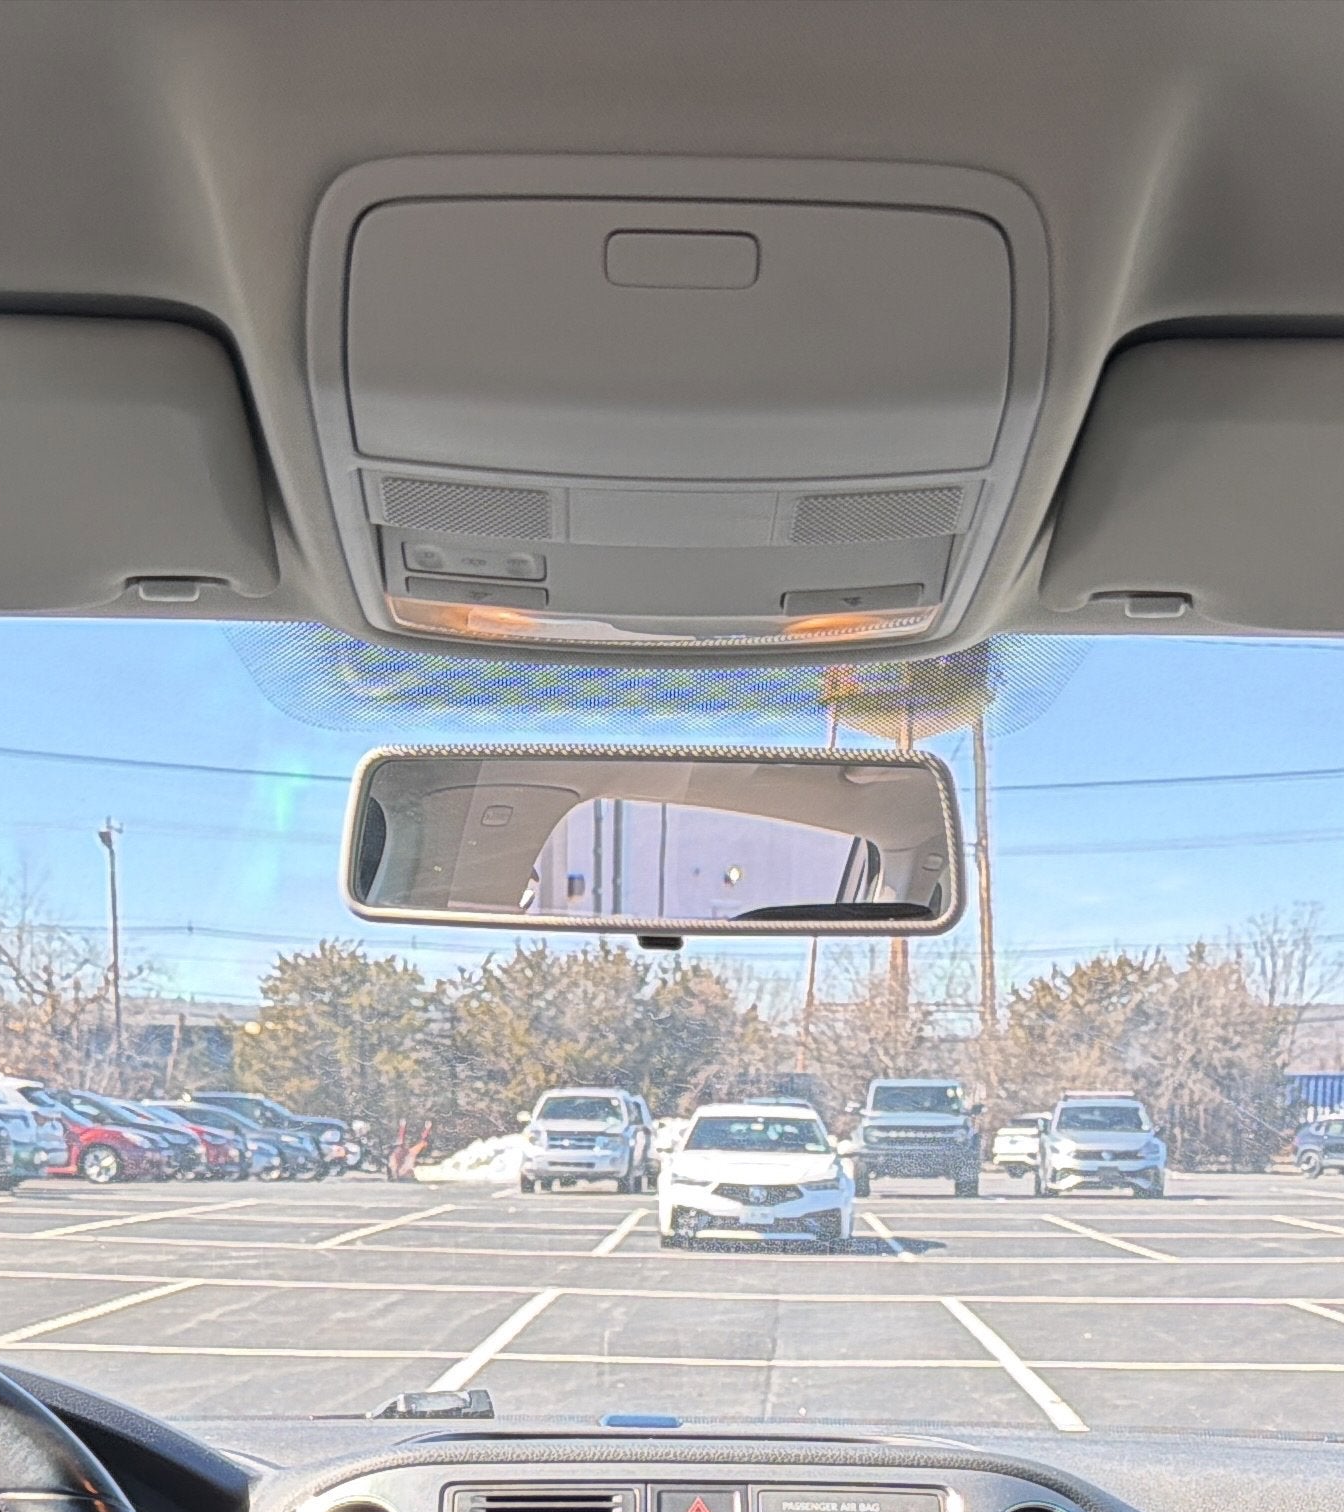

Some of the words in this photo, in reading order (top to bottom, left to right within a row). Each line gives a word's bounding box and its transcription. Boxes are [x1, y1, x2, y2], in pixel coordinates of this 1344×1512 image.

[781, 1501, 838, 1512] PASSENGER
[840, 1502, 856, 1512] AIR
[858, 1502, 880, 1512] BAG
